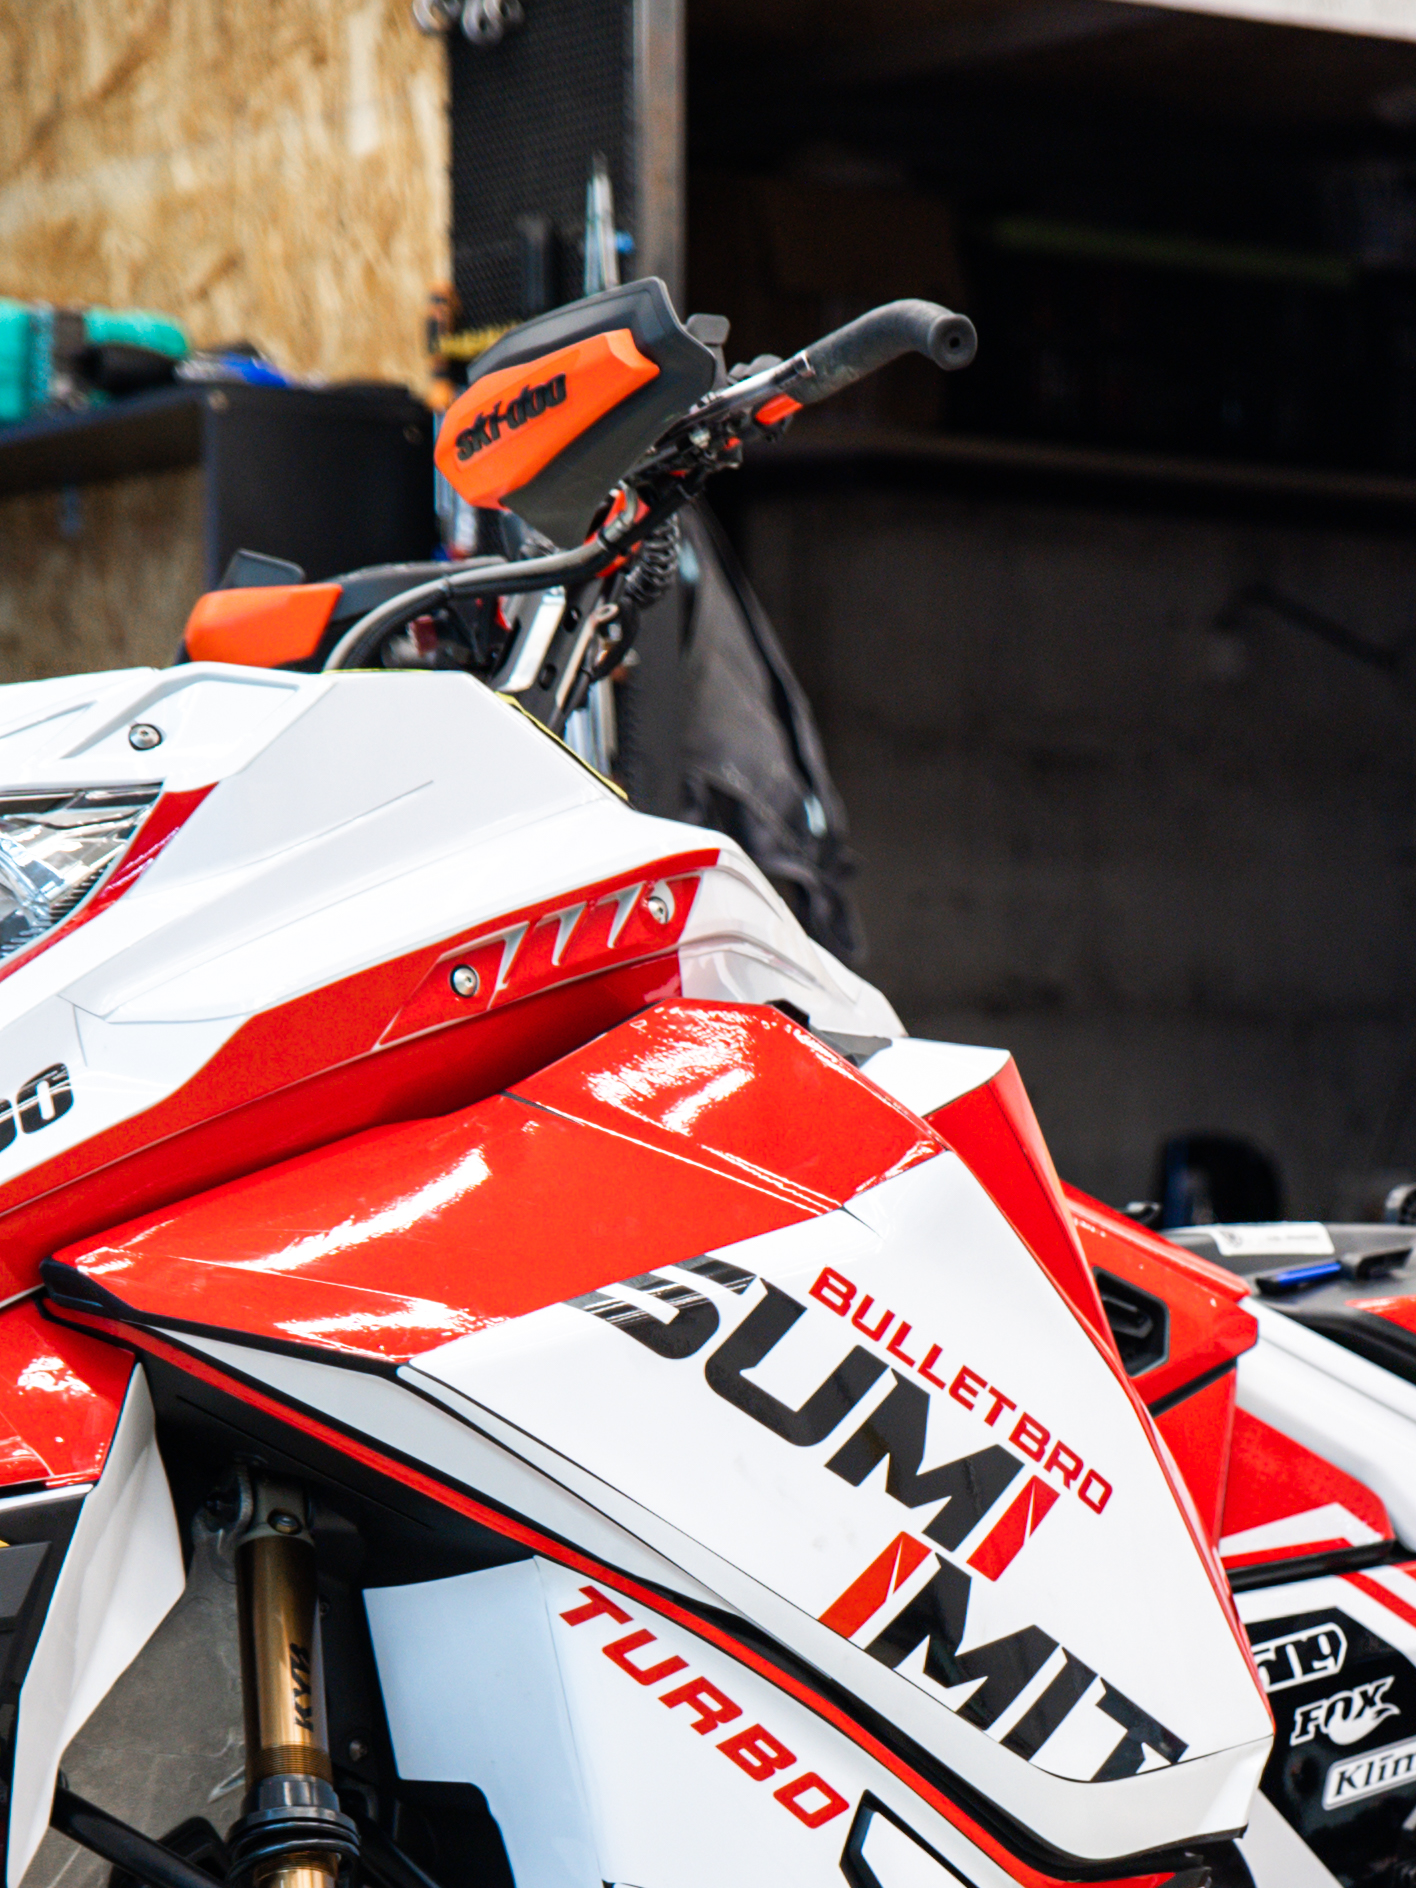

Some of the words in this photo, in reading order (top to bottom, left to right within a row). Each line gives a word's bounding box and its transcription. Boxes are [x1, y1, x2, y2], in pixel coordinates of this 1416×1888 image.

[809, 1266, 1113, 1514] BULLETBRO
[559, 1585, 850, 1829] TURBO
[1289, 1675, 1396, 1747] FOX
